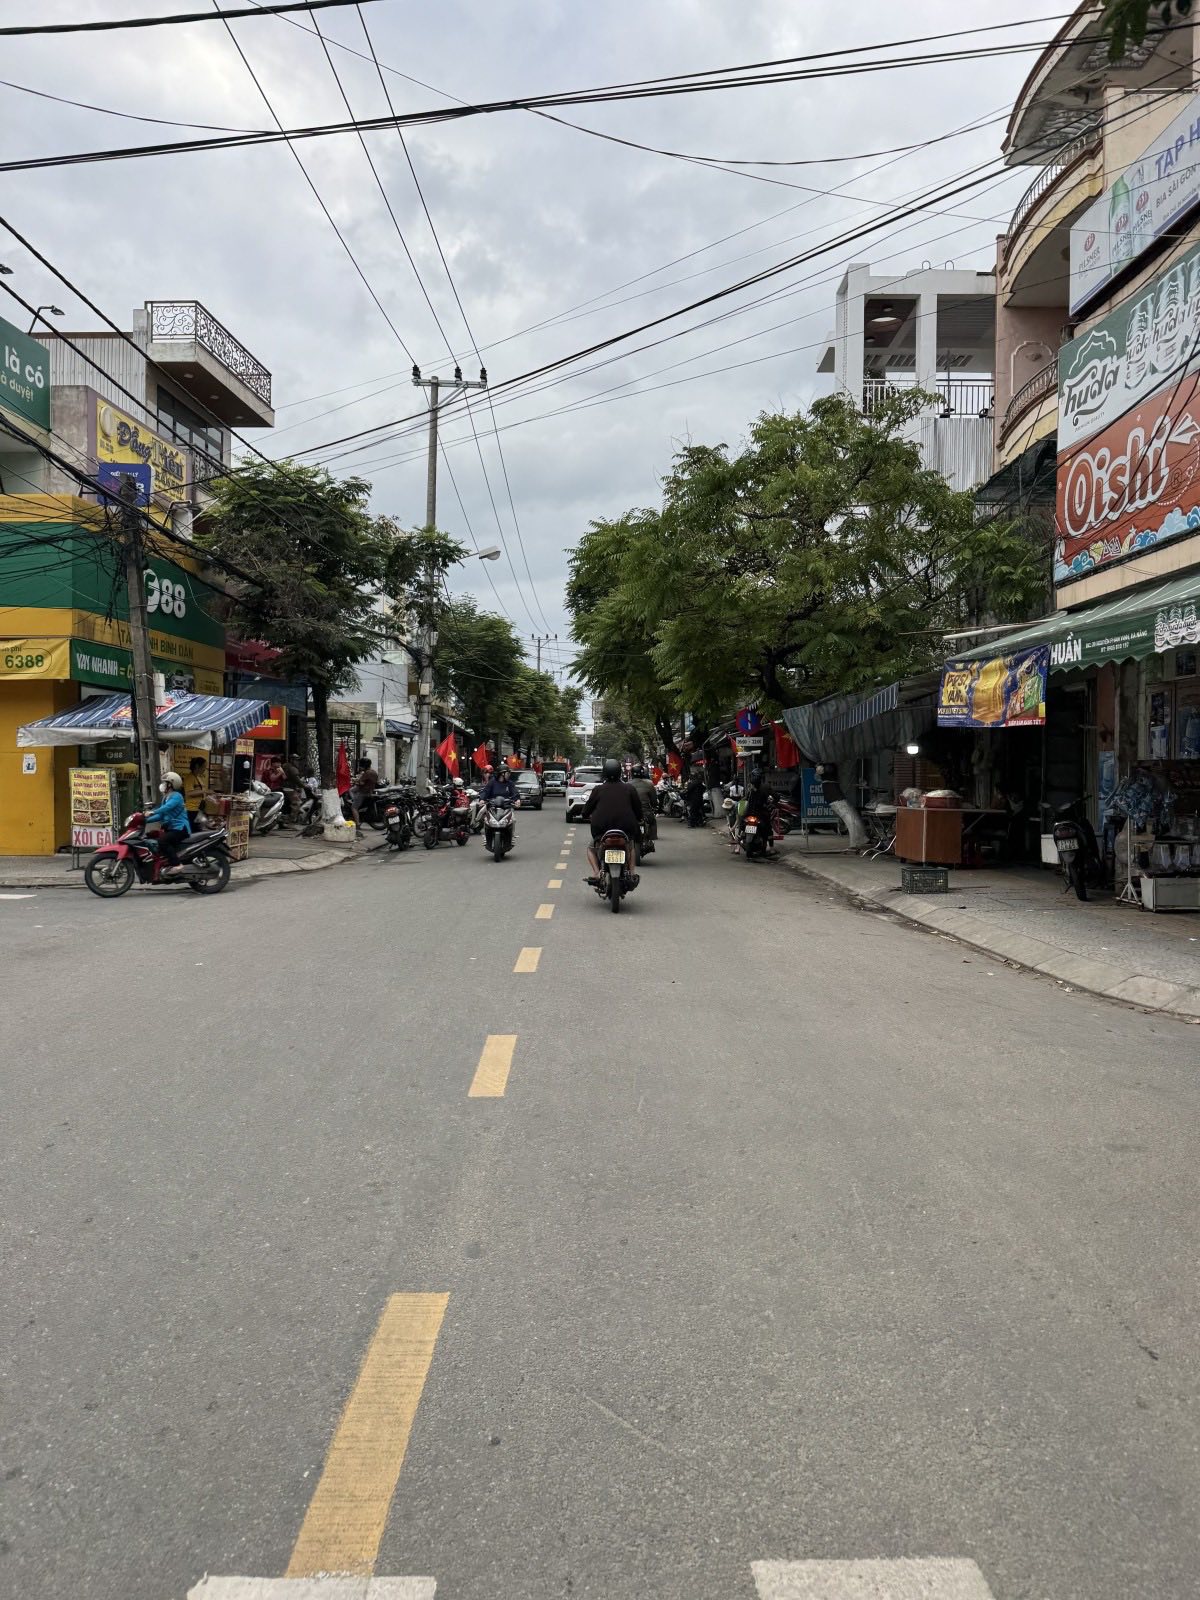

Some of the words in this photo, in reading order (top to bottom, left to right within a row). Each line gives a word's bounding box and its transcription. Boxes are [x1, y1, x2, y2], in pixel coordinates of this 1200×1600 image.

[1155, 134, 1185, 181] TẠP
[1156, 192, 1167, 208] BIA
[1079, 246, 1100, 273] PILSNER
[5, 345, 20, 375] là
[25, 364, 44, 389] có
[1063, 361, 1122, 418] huda
[1064, 414, 1172, 538] Oishi
[5, 654, 45, 669] 6388
[76, 653, 91, 671] VAY
[91, 656, 119, 677] NHANH
[74, 828, 93, 845] XÔI
[96, 828, 113, 845] GÀ
